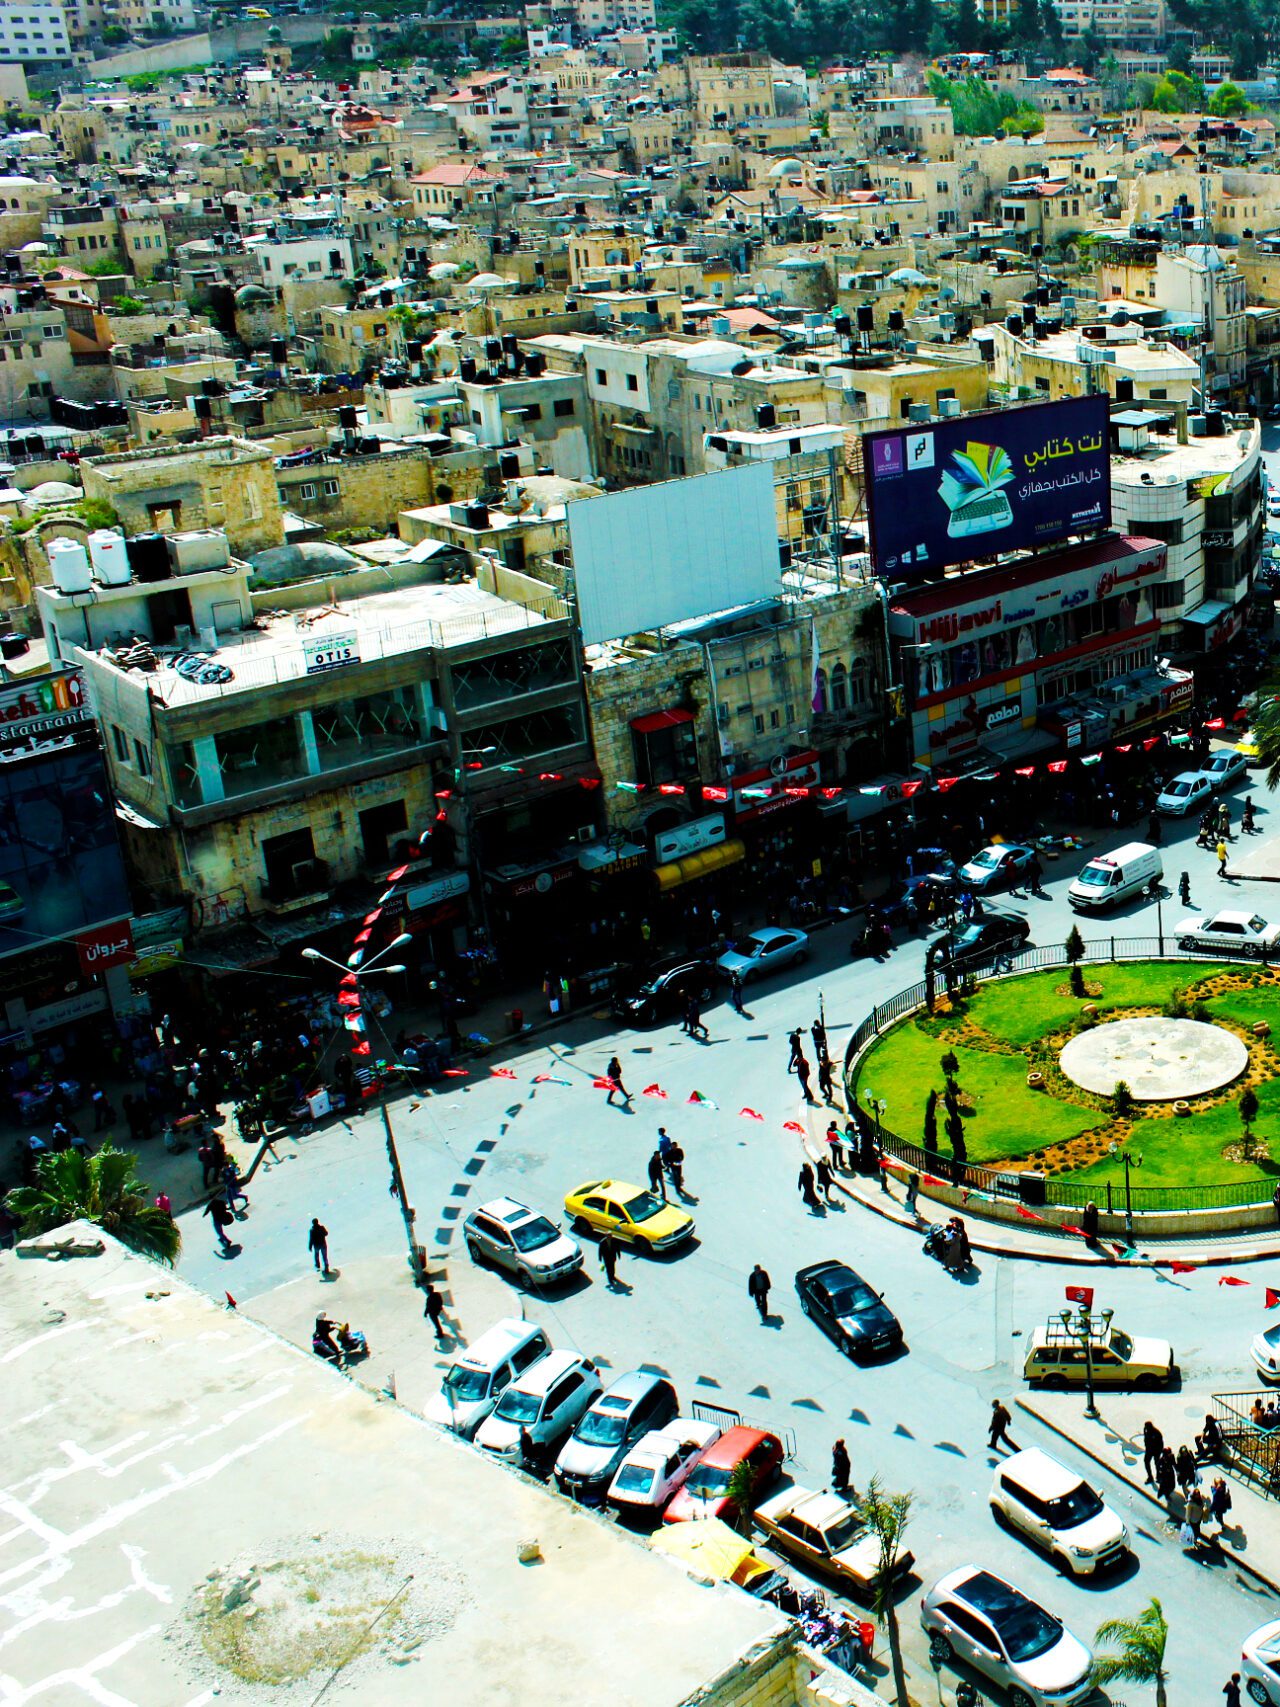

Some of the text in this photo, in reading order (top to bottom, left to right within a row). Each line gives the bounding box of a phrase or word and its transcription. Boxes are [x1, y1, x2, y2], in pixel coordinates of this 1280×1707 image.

[1024, 430, 1103, 473] نت كتابي
[1018, 467, 1101, 501] كل الكتب بجهازي
[919, 600, 1003, 644] Hijjawi
[315, 648, 351, 664] OTIS
[986, 704, 1021, 731] مطعم
[85, 938, 129, 962] جروان
